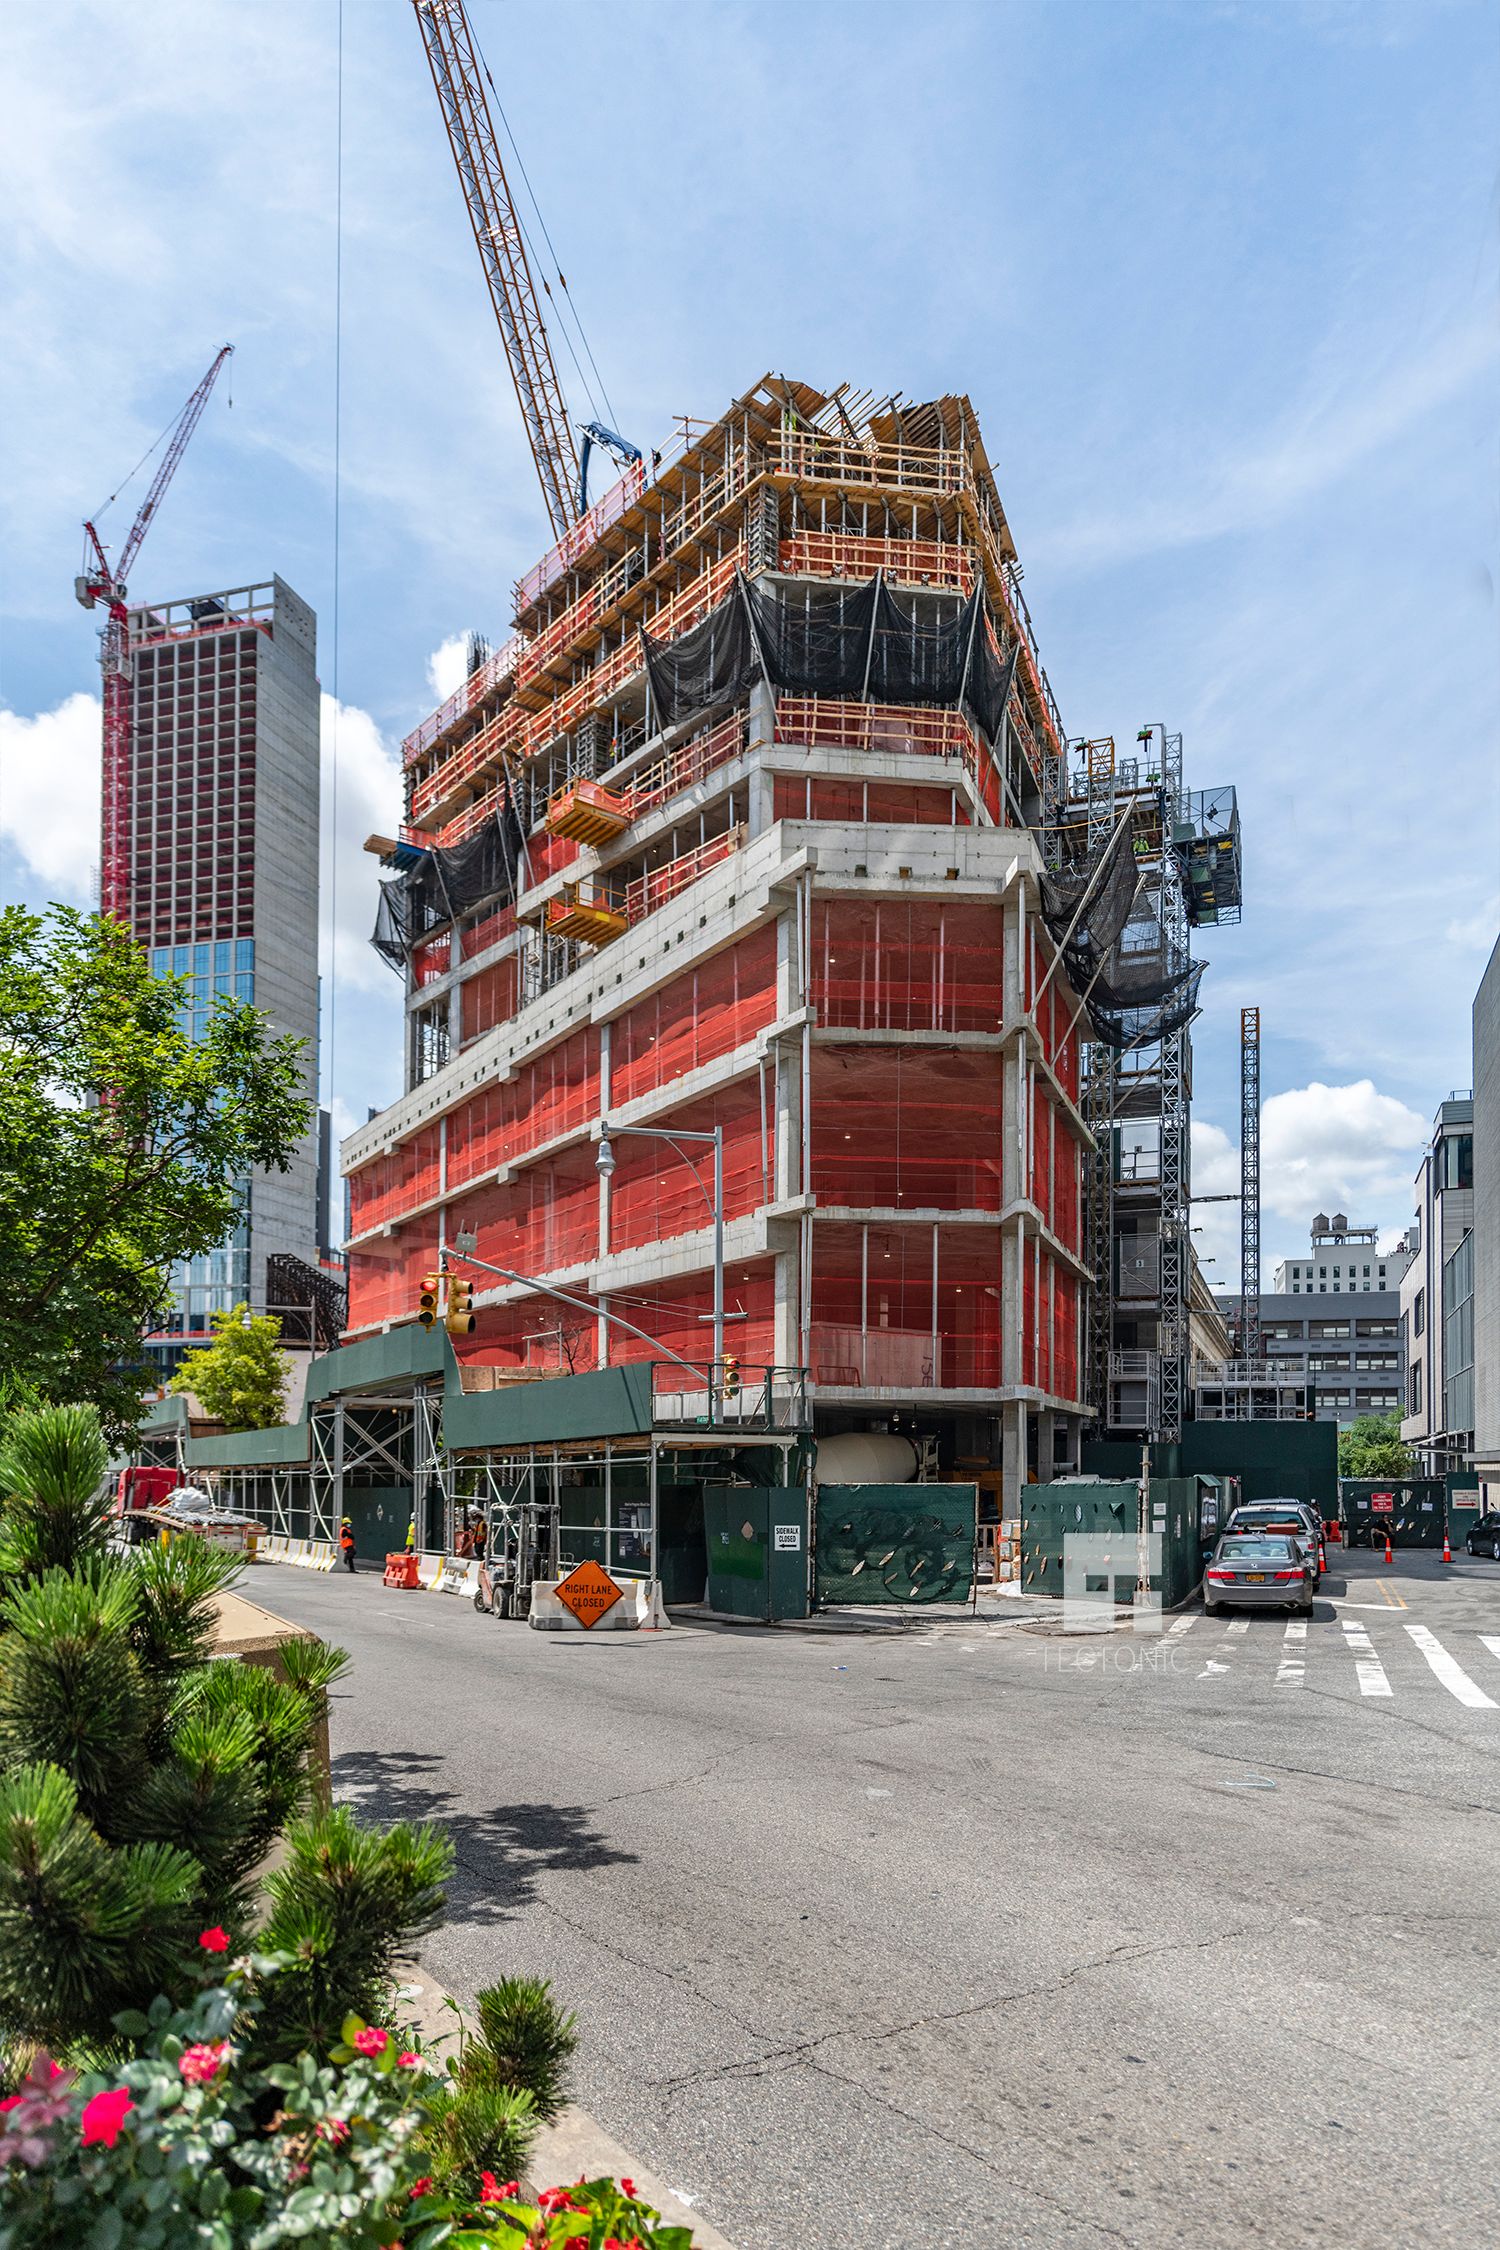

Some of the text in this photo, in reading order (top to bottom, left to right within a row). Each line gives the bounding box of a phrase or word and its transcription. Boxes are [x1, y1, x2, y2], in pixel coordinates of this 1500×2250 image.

[776, 1527, 799, 1535] SIDEWALK
[778, 1535, 797, 1543] CLOSED
[565, 1584, 613, 1595] RIGHT LANE
[572, 1597, 605, 1608] CLOSED
